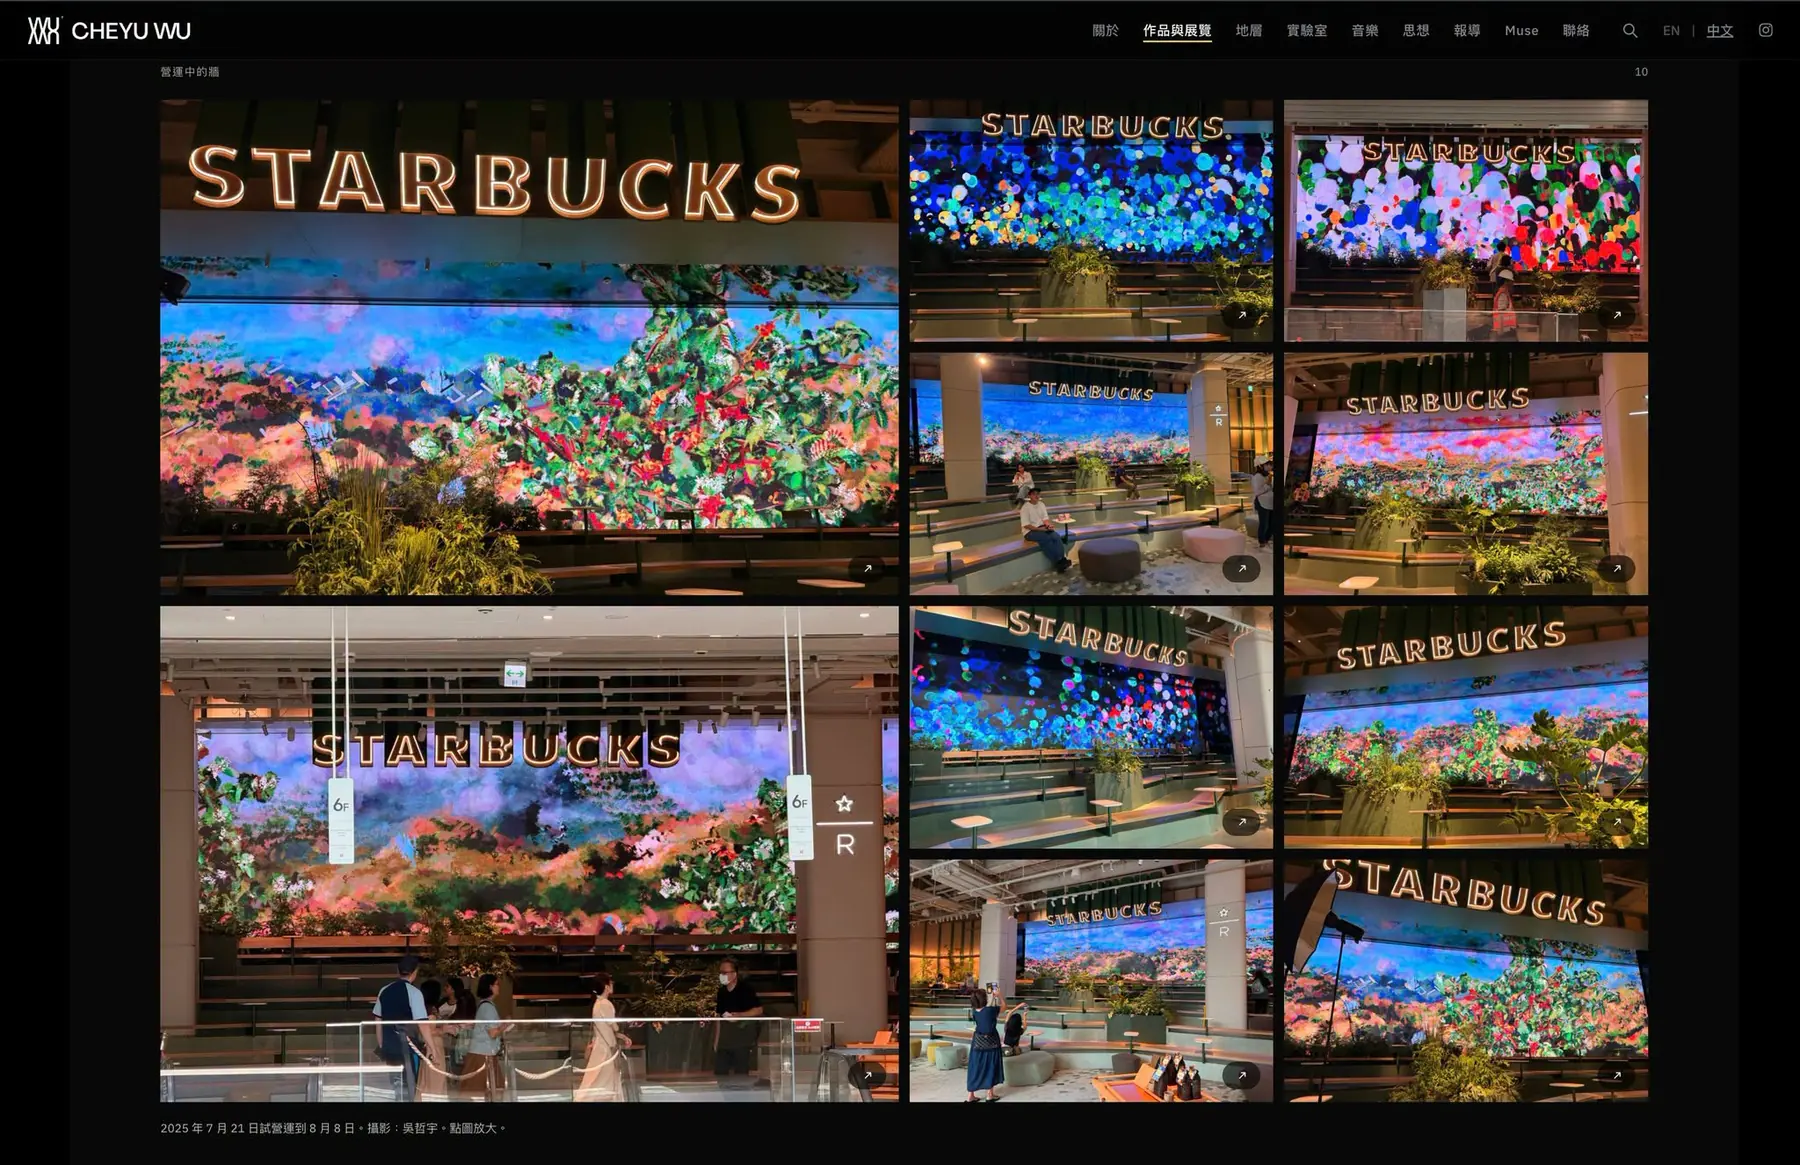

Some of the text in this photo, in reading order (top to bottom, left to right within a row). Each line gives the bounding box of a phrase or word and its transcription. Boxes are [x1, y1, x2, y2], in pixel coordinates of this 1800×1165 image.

[981, 112, 1225, 139] STARBUCKS
[1363, 141, 1576, 165] STARBUCKS
[188, 144, 801, 224] STARBUCKS
[1028, 380, 1154, 402] STARBUCKS
[1346, 387, 1530, 416] STARBUCKS
[1215, 418, 1223, 427] R
[1009, 609, 1189, 668] STARBUCKS
[1337, 621, 1567, 670] STARBUCKS
[312, 733, 681, 768] STARBUCKS
[333, 797, 350, 812] 6F
[792, 794, 808, 808] 6F
[837, 834, 855, 856] R
[1322, 859, 1606, 927] STARBUCKS
[1046, 901, 1162, 927] STARBUCKS
[1219, 926, 1230, 937] R
